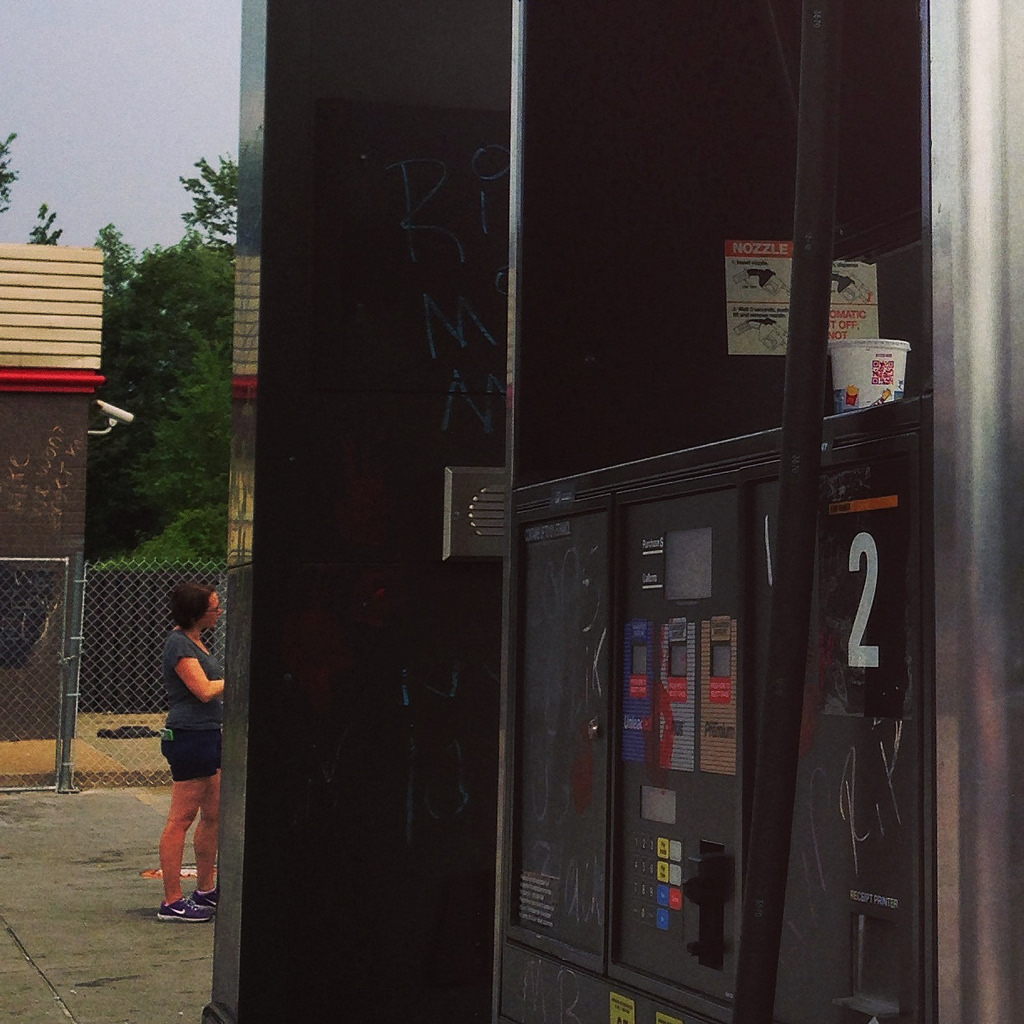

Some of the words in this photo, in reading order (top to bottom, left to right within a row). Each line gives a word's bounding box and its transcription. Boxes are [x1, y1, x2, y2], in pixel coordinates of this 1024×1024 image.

[733, 242, 789, 255] NOZZLE
[830, 309, 866, 319] OMATIC
[848, 531, 879, 668] 2
[850, 889, 873, 903] RECEIPT
[874, 893, 899, 909] PRINTER
